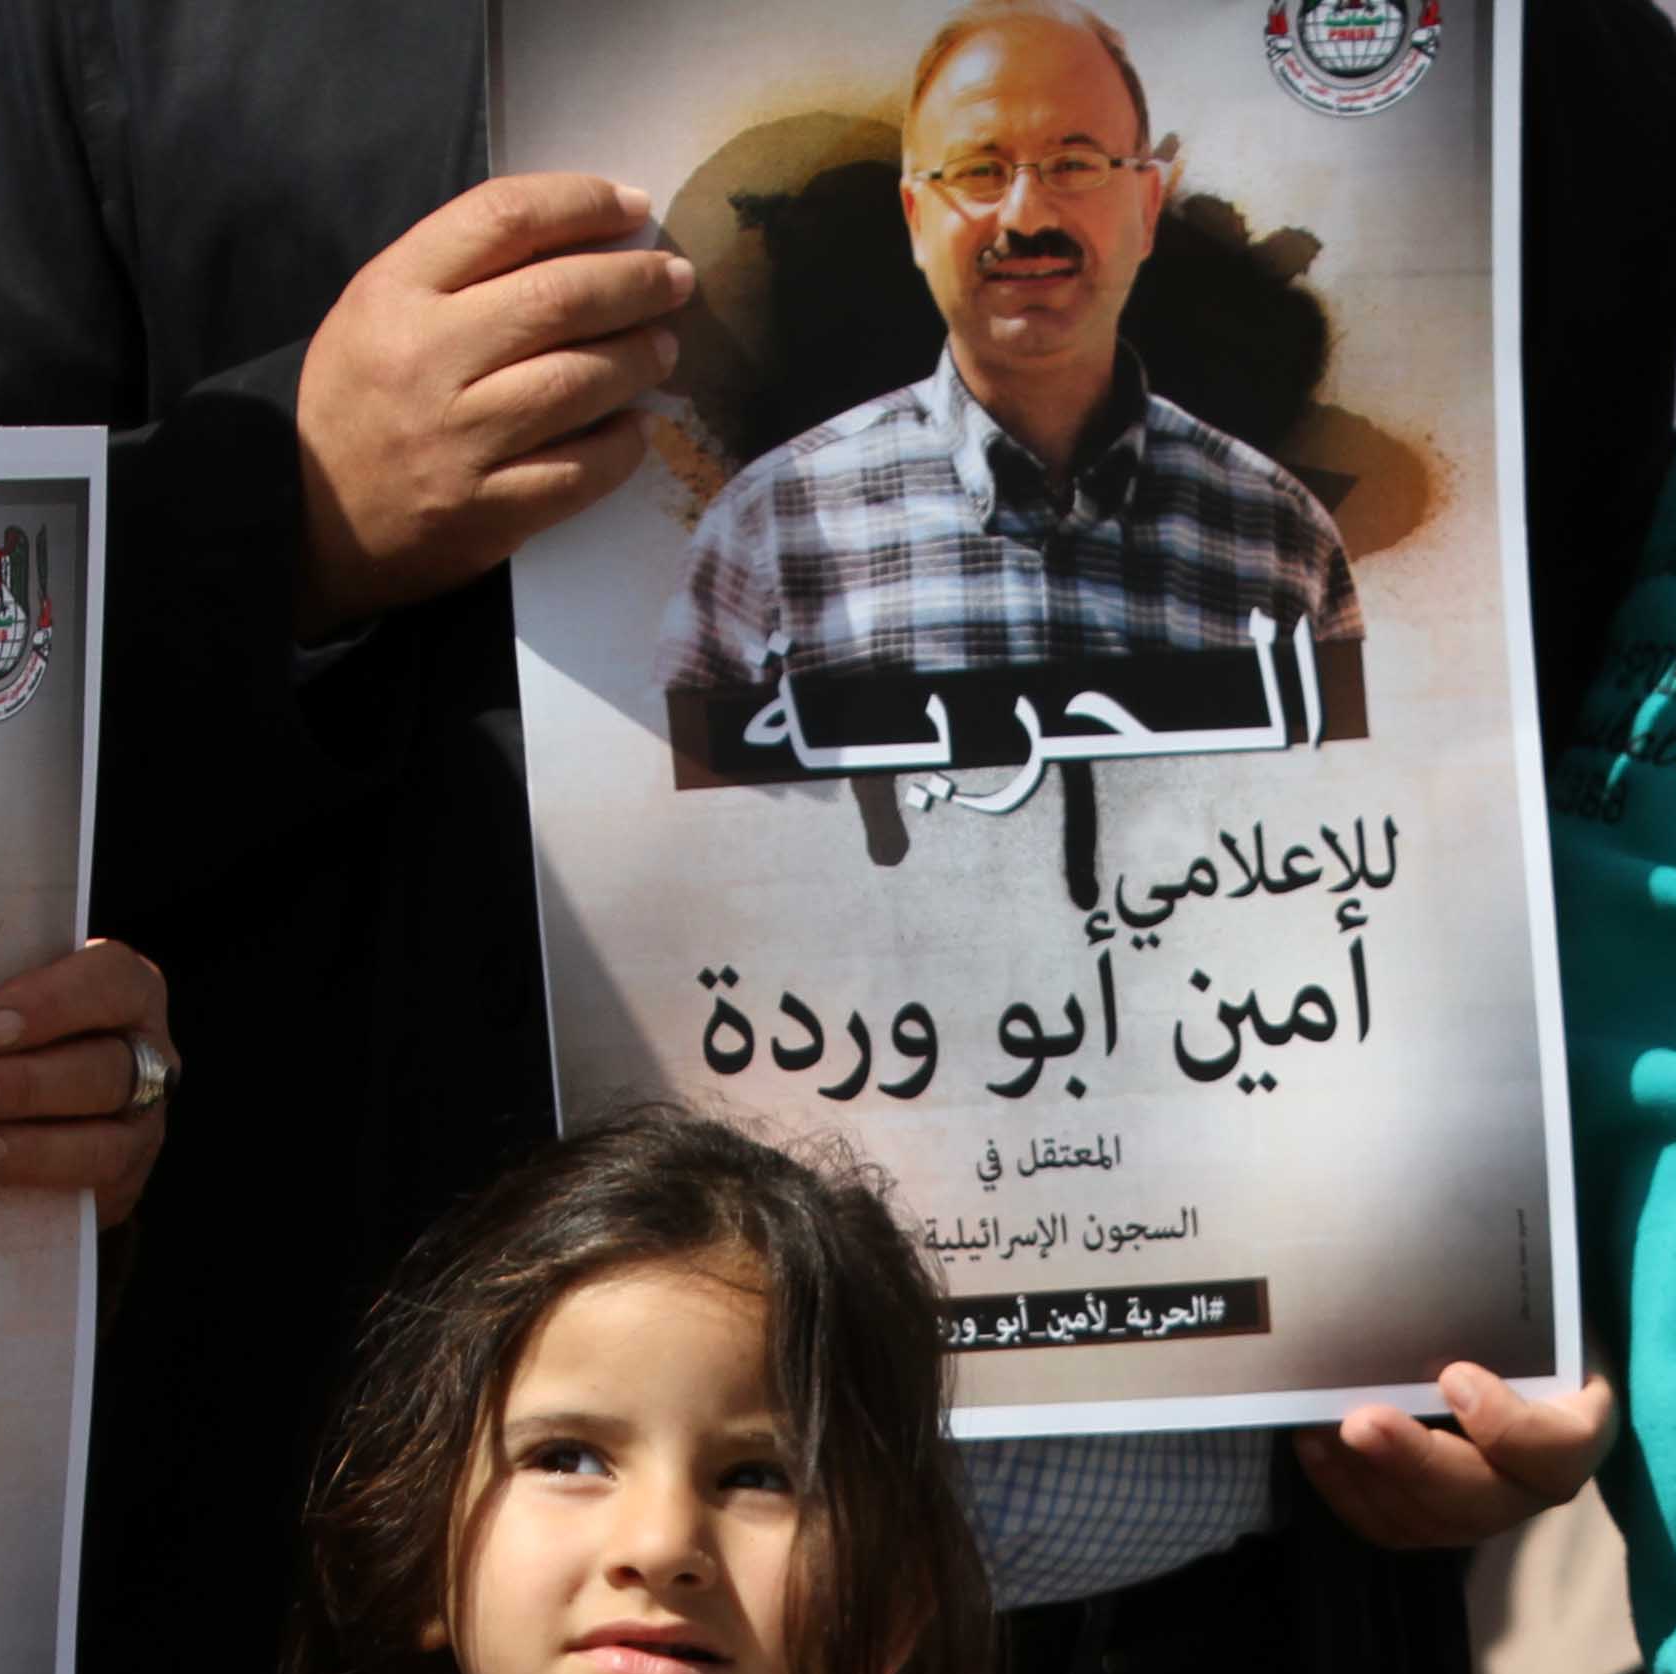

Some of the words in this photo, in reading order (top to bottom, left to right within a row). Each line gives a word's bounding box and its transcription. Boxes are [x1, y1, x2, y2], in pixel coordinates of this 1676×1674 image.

[743, 605, 1321, 812] الحرية
[697, 965, 939, 1099] وردة
[985, 910, 1118, 1099] أبو
[1174, 898, 1369, 1095] أمين
[976, 1140, 1004, 1191] في
[1017, 1134, 1122, 1176] المعتقل
[925, 1213, 1067, 1262] الإسرائيلية
[1082, 1207, 1197, 1251] السجون
